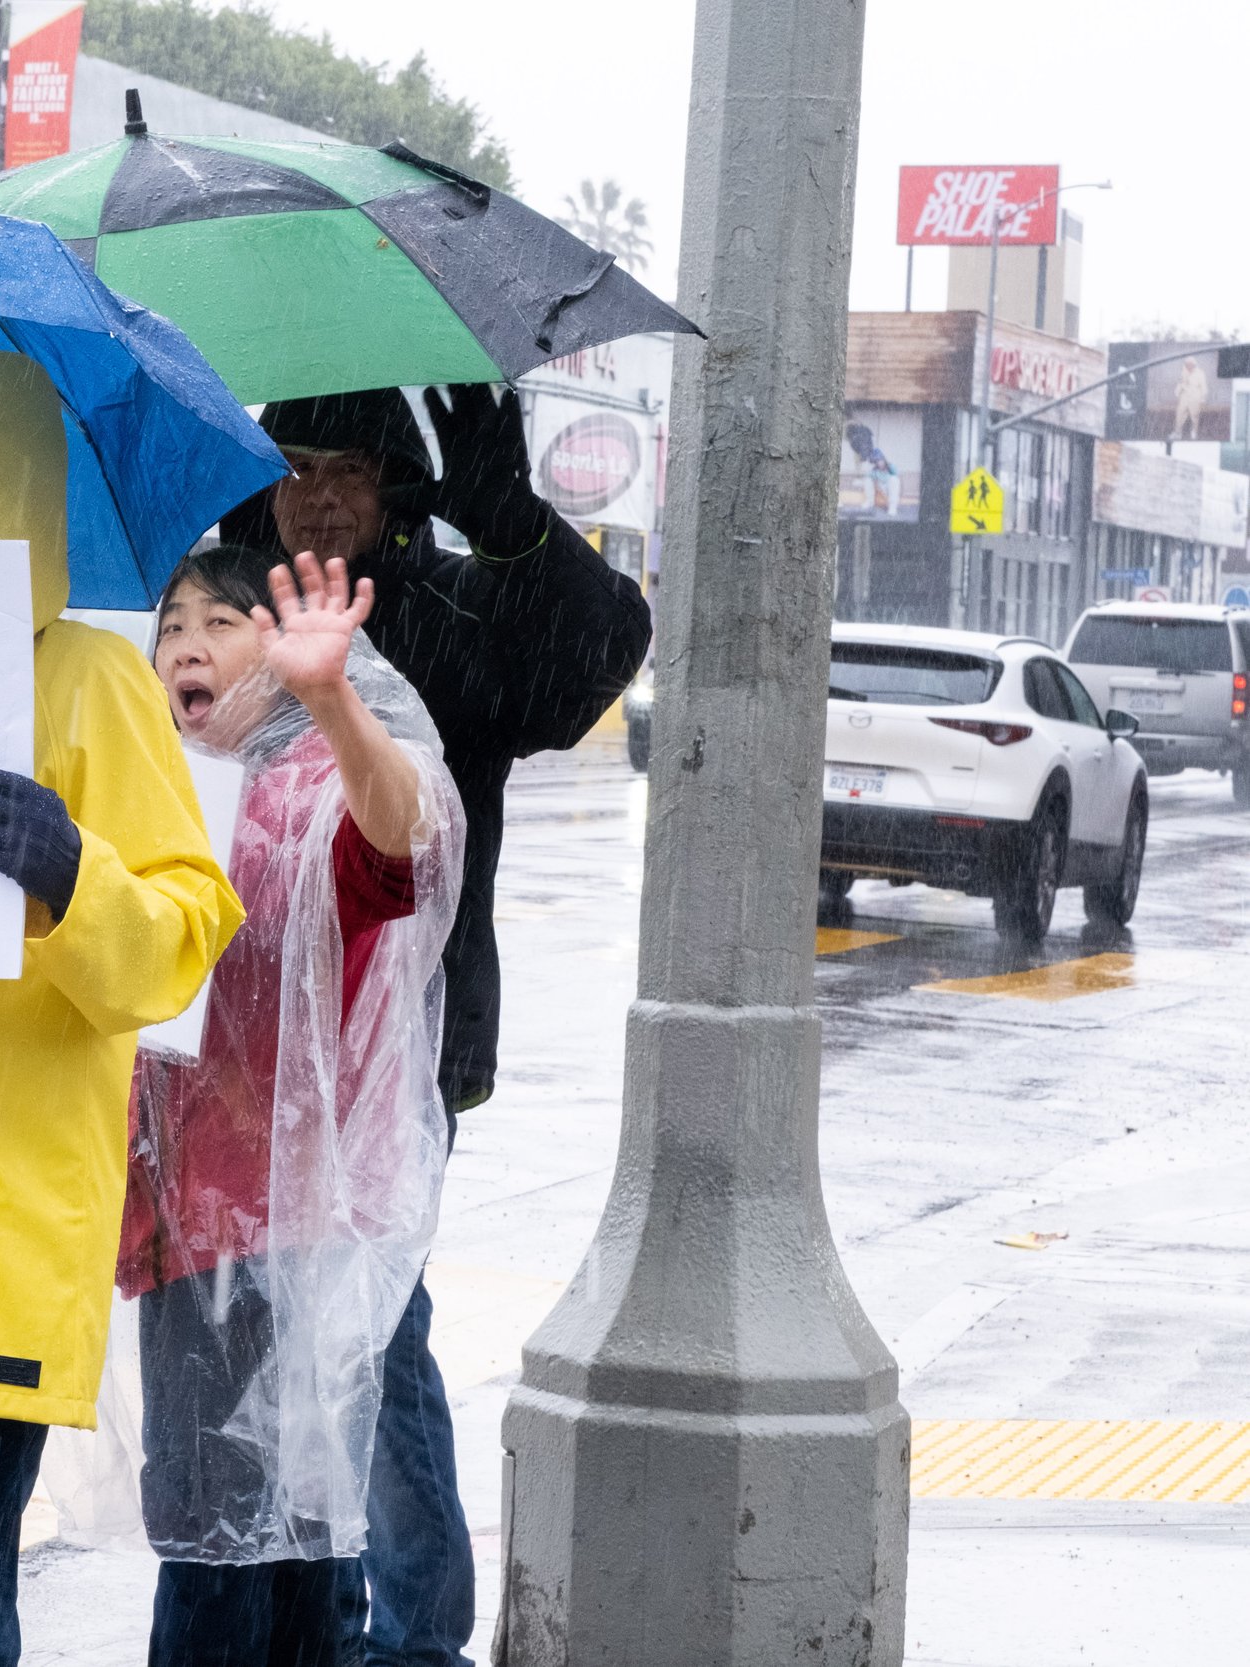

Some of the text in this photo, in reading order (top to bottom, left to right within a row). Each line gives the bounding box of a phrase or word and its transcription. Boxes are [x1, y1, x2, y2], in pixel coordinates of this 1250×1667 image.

[13, 86, 66, 102] FAIRFAX
[928, 171, 1016, 206] SHOE
[914, 202, 1040, 237] PALACE
